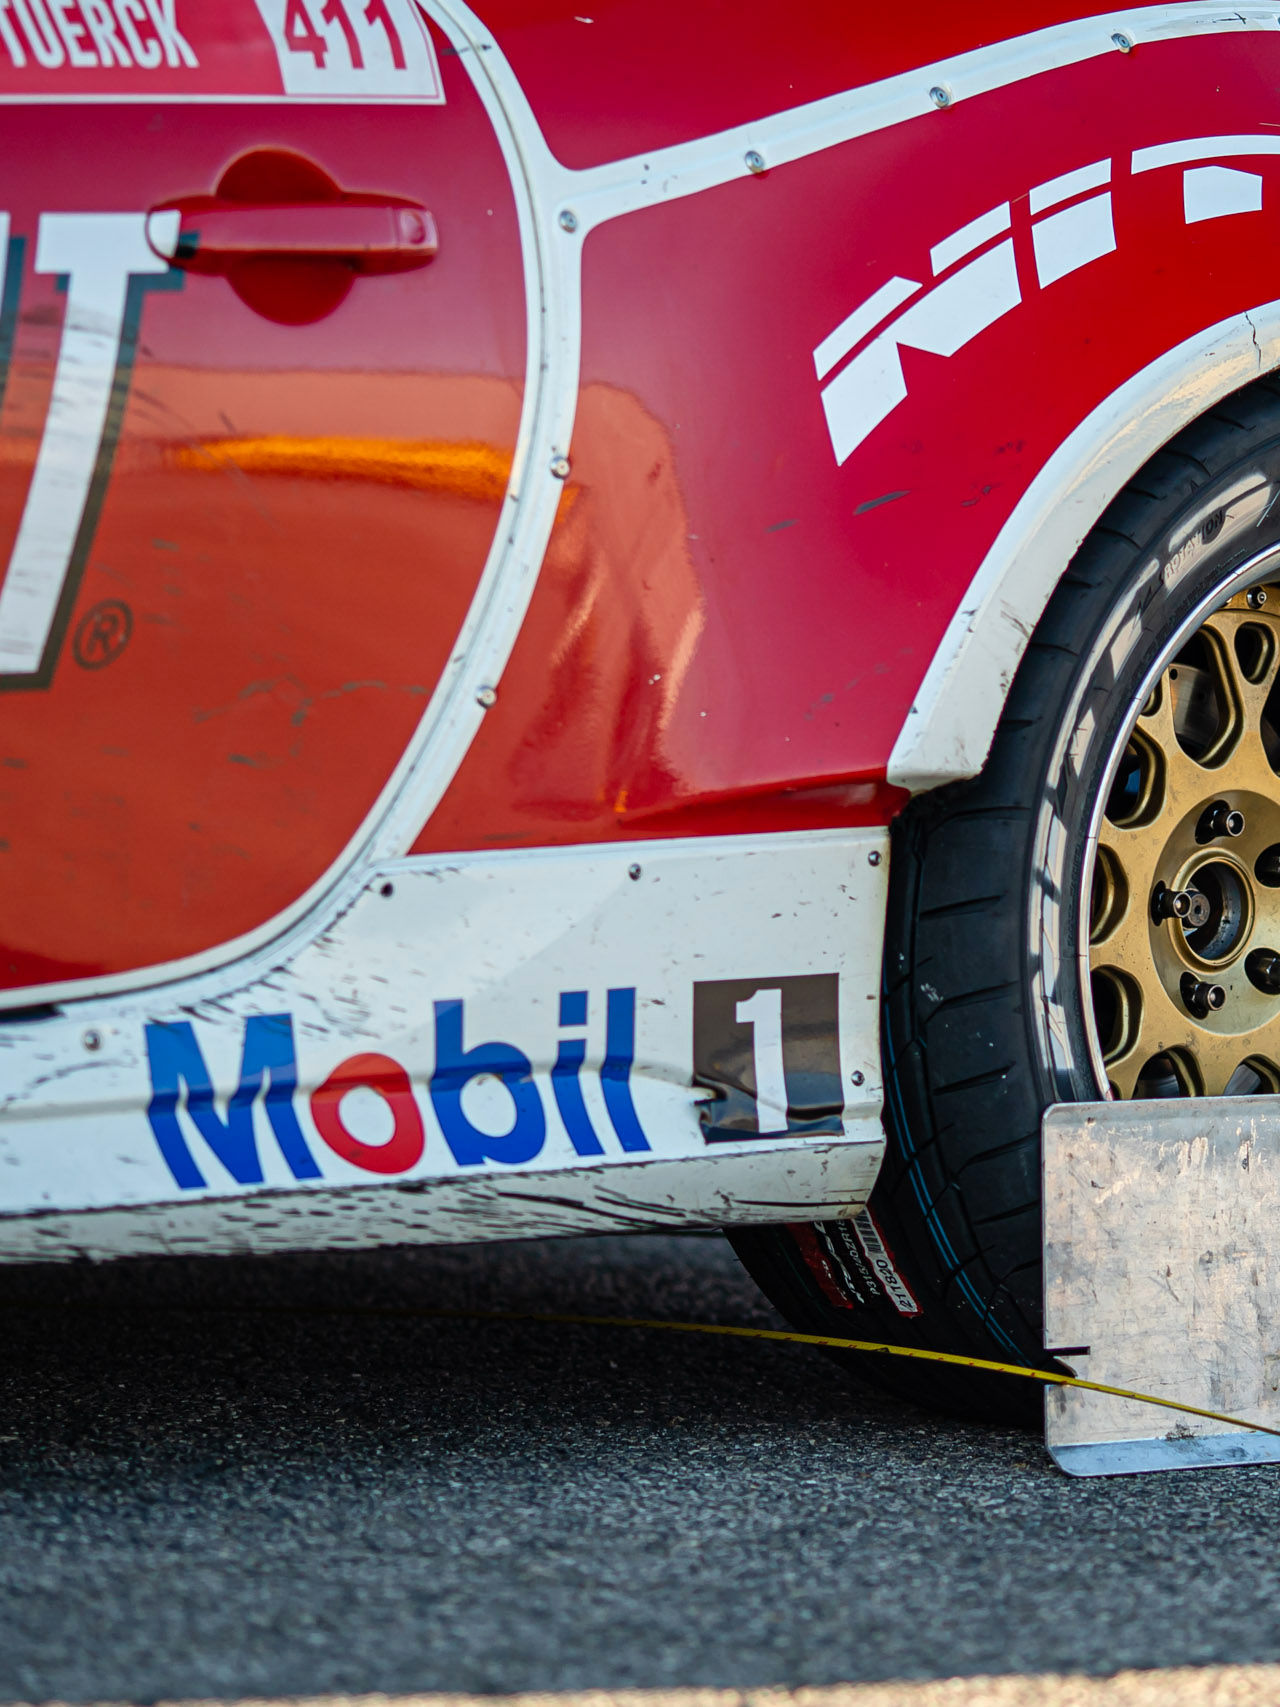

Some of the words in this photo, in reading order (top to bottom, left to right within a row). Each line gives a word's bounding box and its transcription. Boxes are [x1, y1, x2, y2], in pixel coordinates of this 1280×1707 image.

[0, 0, 199, 68] TUERCK
[284, 0, 407, 70] 411
[145, 986, 652, 1190] Mobil
[735, 988, 791, 1133] 1
[876, 1259, 914, 1311] 211820
